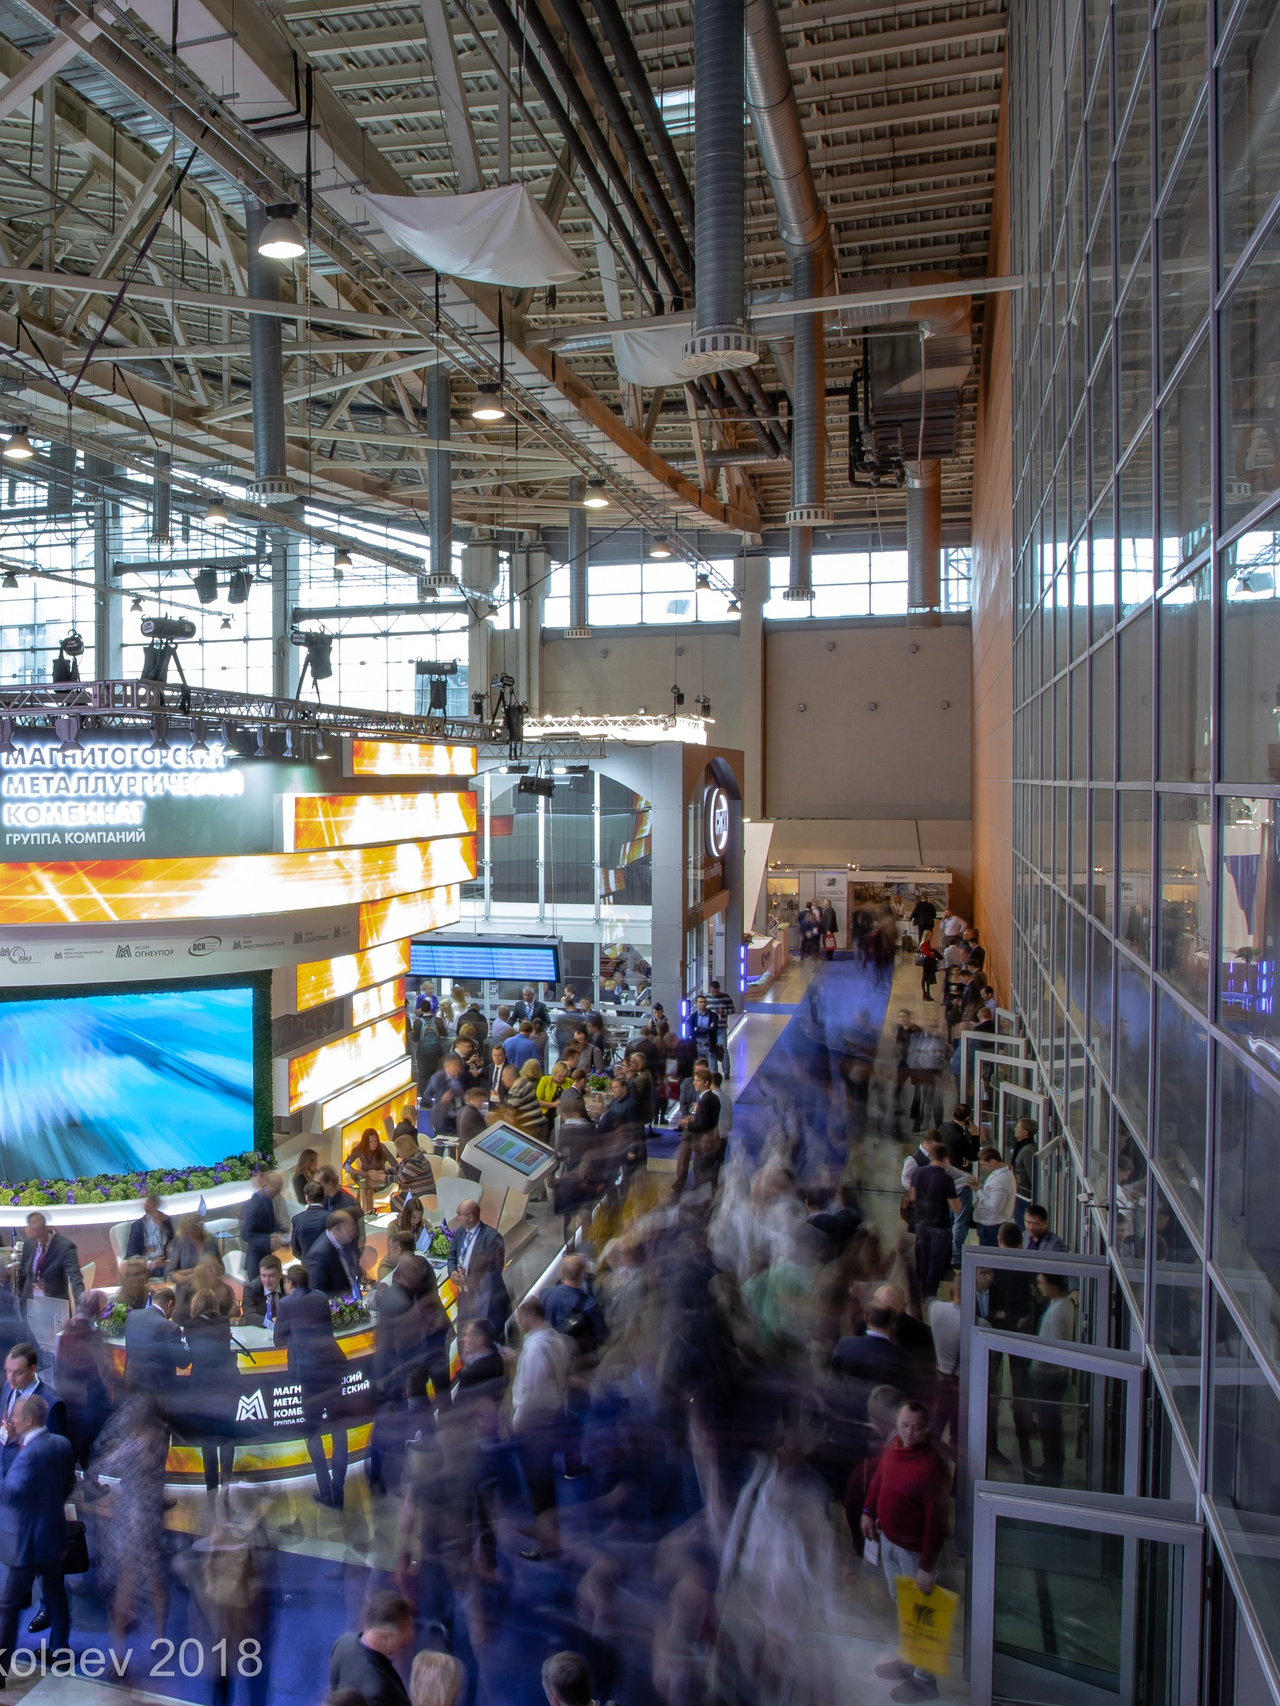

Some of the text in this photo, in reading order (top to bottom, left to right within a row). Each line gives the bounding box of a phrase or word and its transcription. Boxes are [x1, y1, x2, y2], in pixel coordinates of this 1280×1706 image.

[5, 803, 146, 826] КОМБИНАТ
[6, 828, 146, 845] ГРУППА КОМПАНИЙ
[193, 943, 206, 952] ОСК
[135, 949, 174, 958] ОГНЕУПОР
[273, 1418, 295, 1427] ГРУППА
